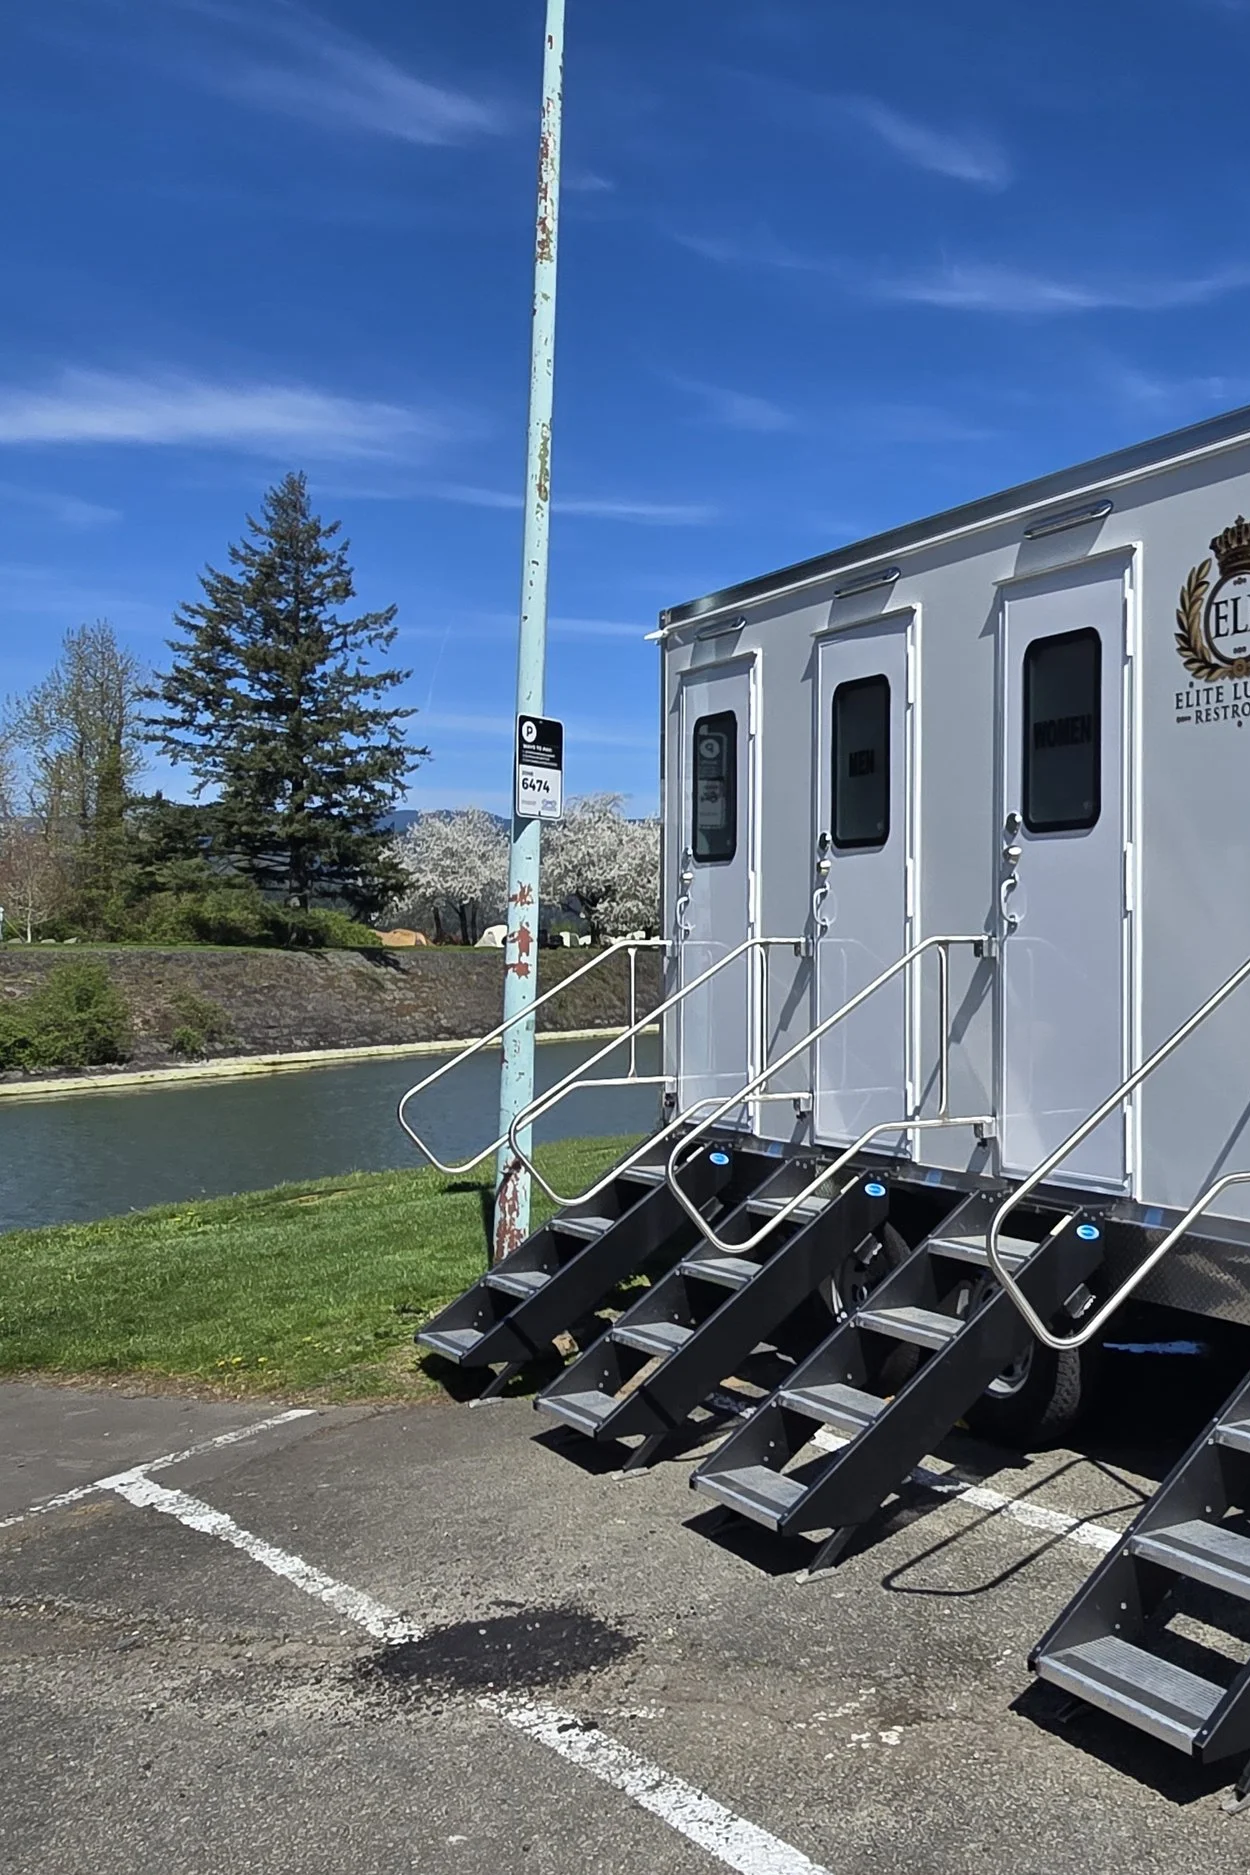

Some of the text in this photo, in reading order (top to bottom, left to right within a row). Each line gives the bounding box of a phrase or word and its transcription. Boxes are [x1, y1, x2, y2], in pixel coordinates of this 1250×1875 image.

[1175, 685, 1225, 710] ELITE
[1033, 714, 1093, 751] WOMEN
[848, 749, 875, 778] MEN
[521, 778, 550, 793] 6474
